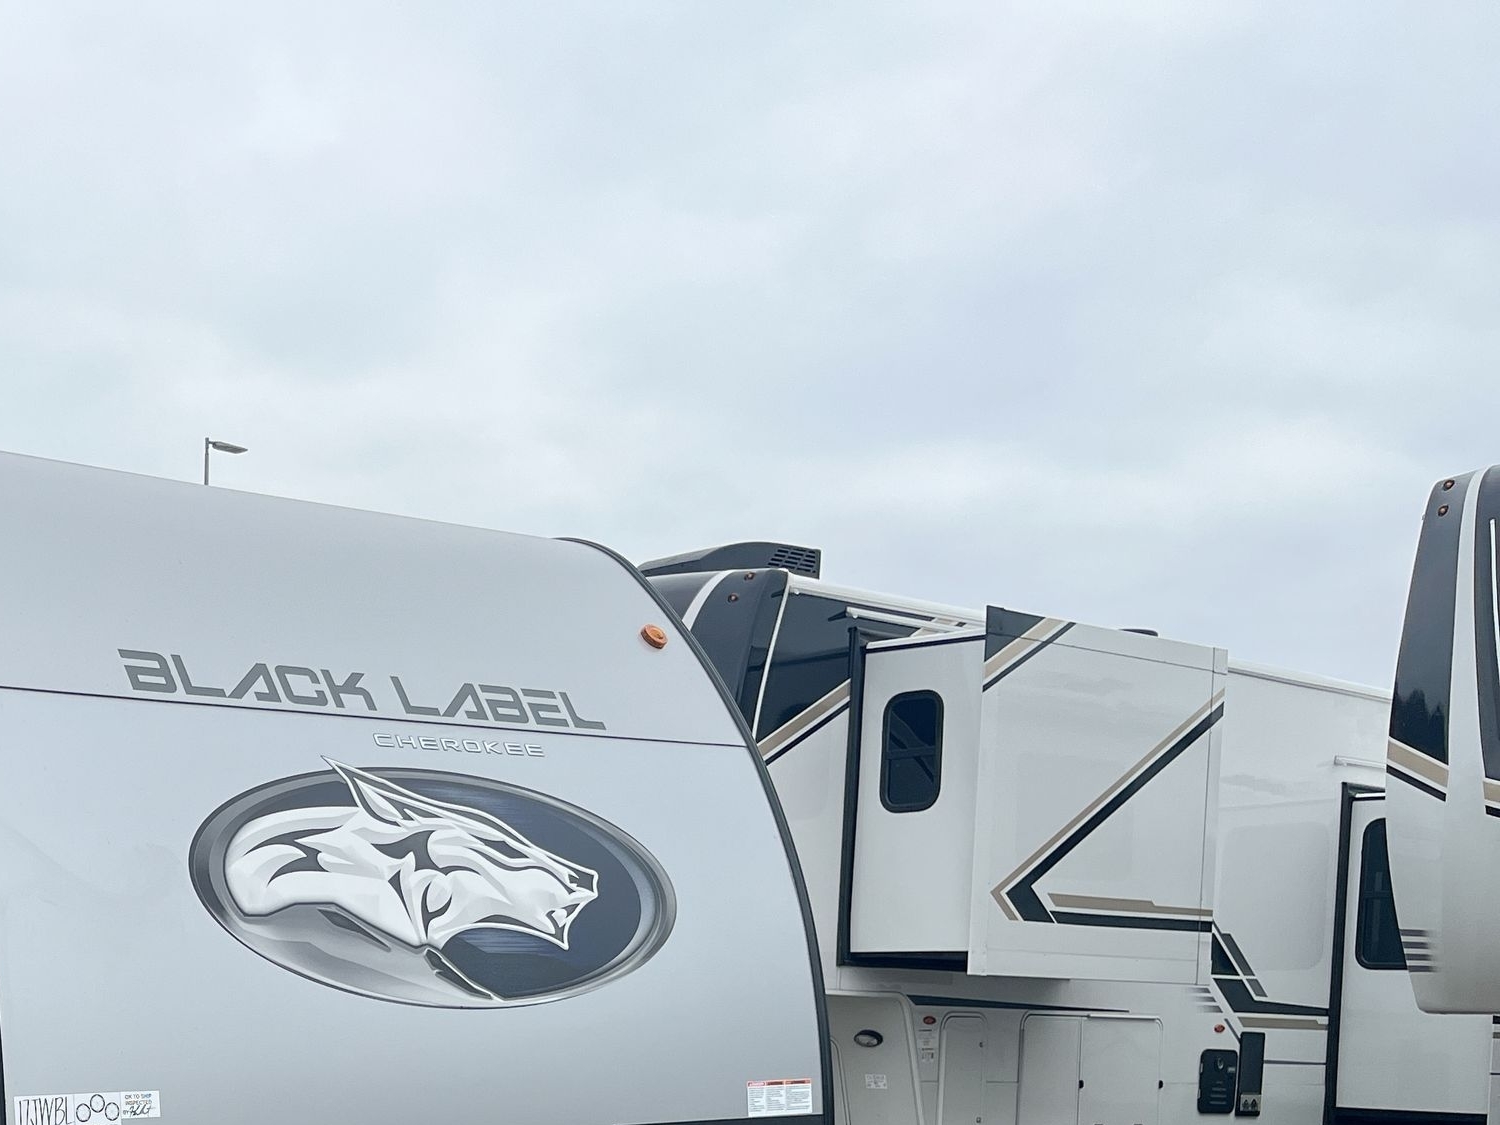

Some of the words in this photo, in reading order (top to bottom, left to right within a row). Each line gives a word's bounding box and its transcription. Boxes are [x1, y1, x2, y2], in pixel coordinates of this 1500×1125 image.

[117, 648, 378, 711] BLACK
[390, 675, 607, 731] LABEL
[373, 732, 546, 758] CHEROKEE
